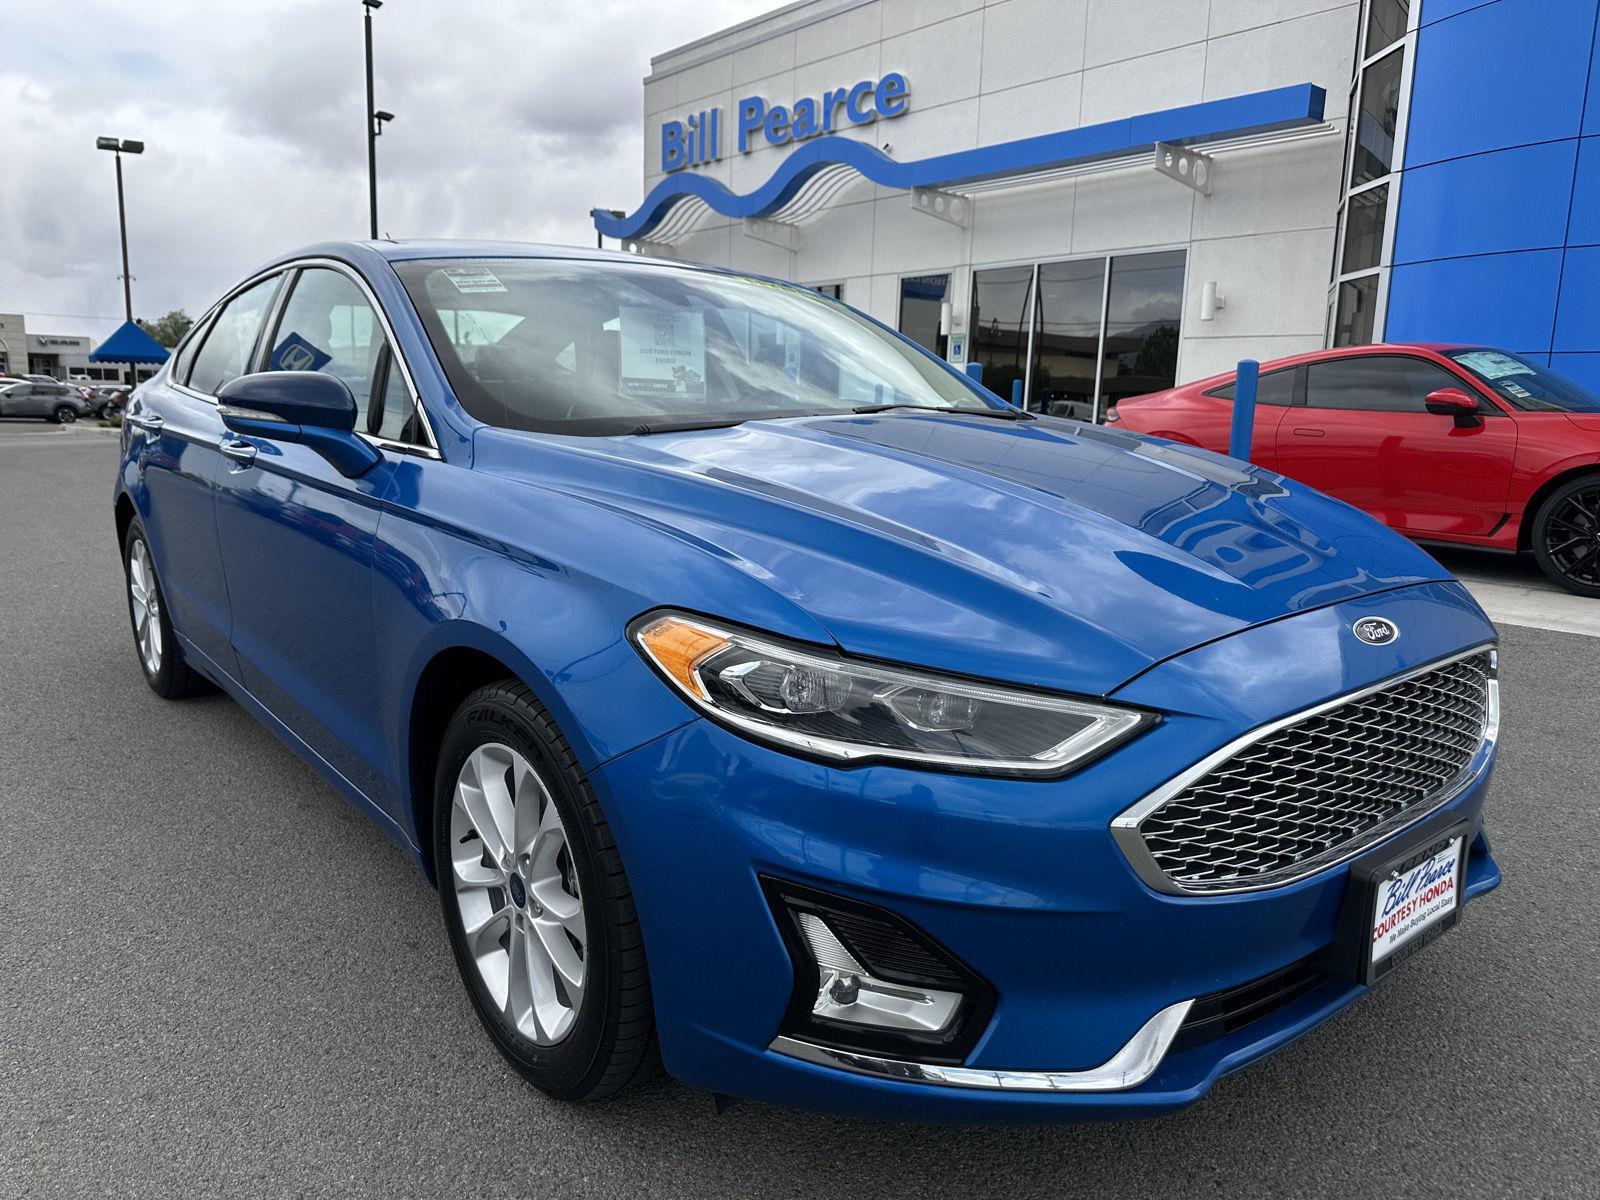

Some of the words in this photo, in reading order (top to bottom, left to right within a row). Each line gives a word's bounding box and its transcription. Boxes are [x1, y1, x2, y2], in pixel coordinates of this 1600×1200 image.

[661, 107, 723, 172] Bill
[738, 72, 911, 154] Pearce
[1363, 622, 1390, 640] Ford
[1381, 868, 1421, 918] Bill
[1414, 857, 1456, 893] Pearce
[1419, 876, 1454, 908] HONDA
[1389, 933, 1397, 944] We
[1397, 923, 1410, 937] Make
[1410, 912, 1427, 928] Buying
[1426, 901, 1440, 916] Local
[1440, 896, 1454, 908] Easy
